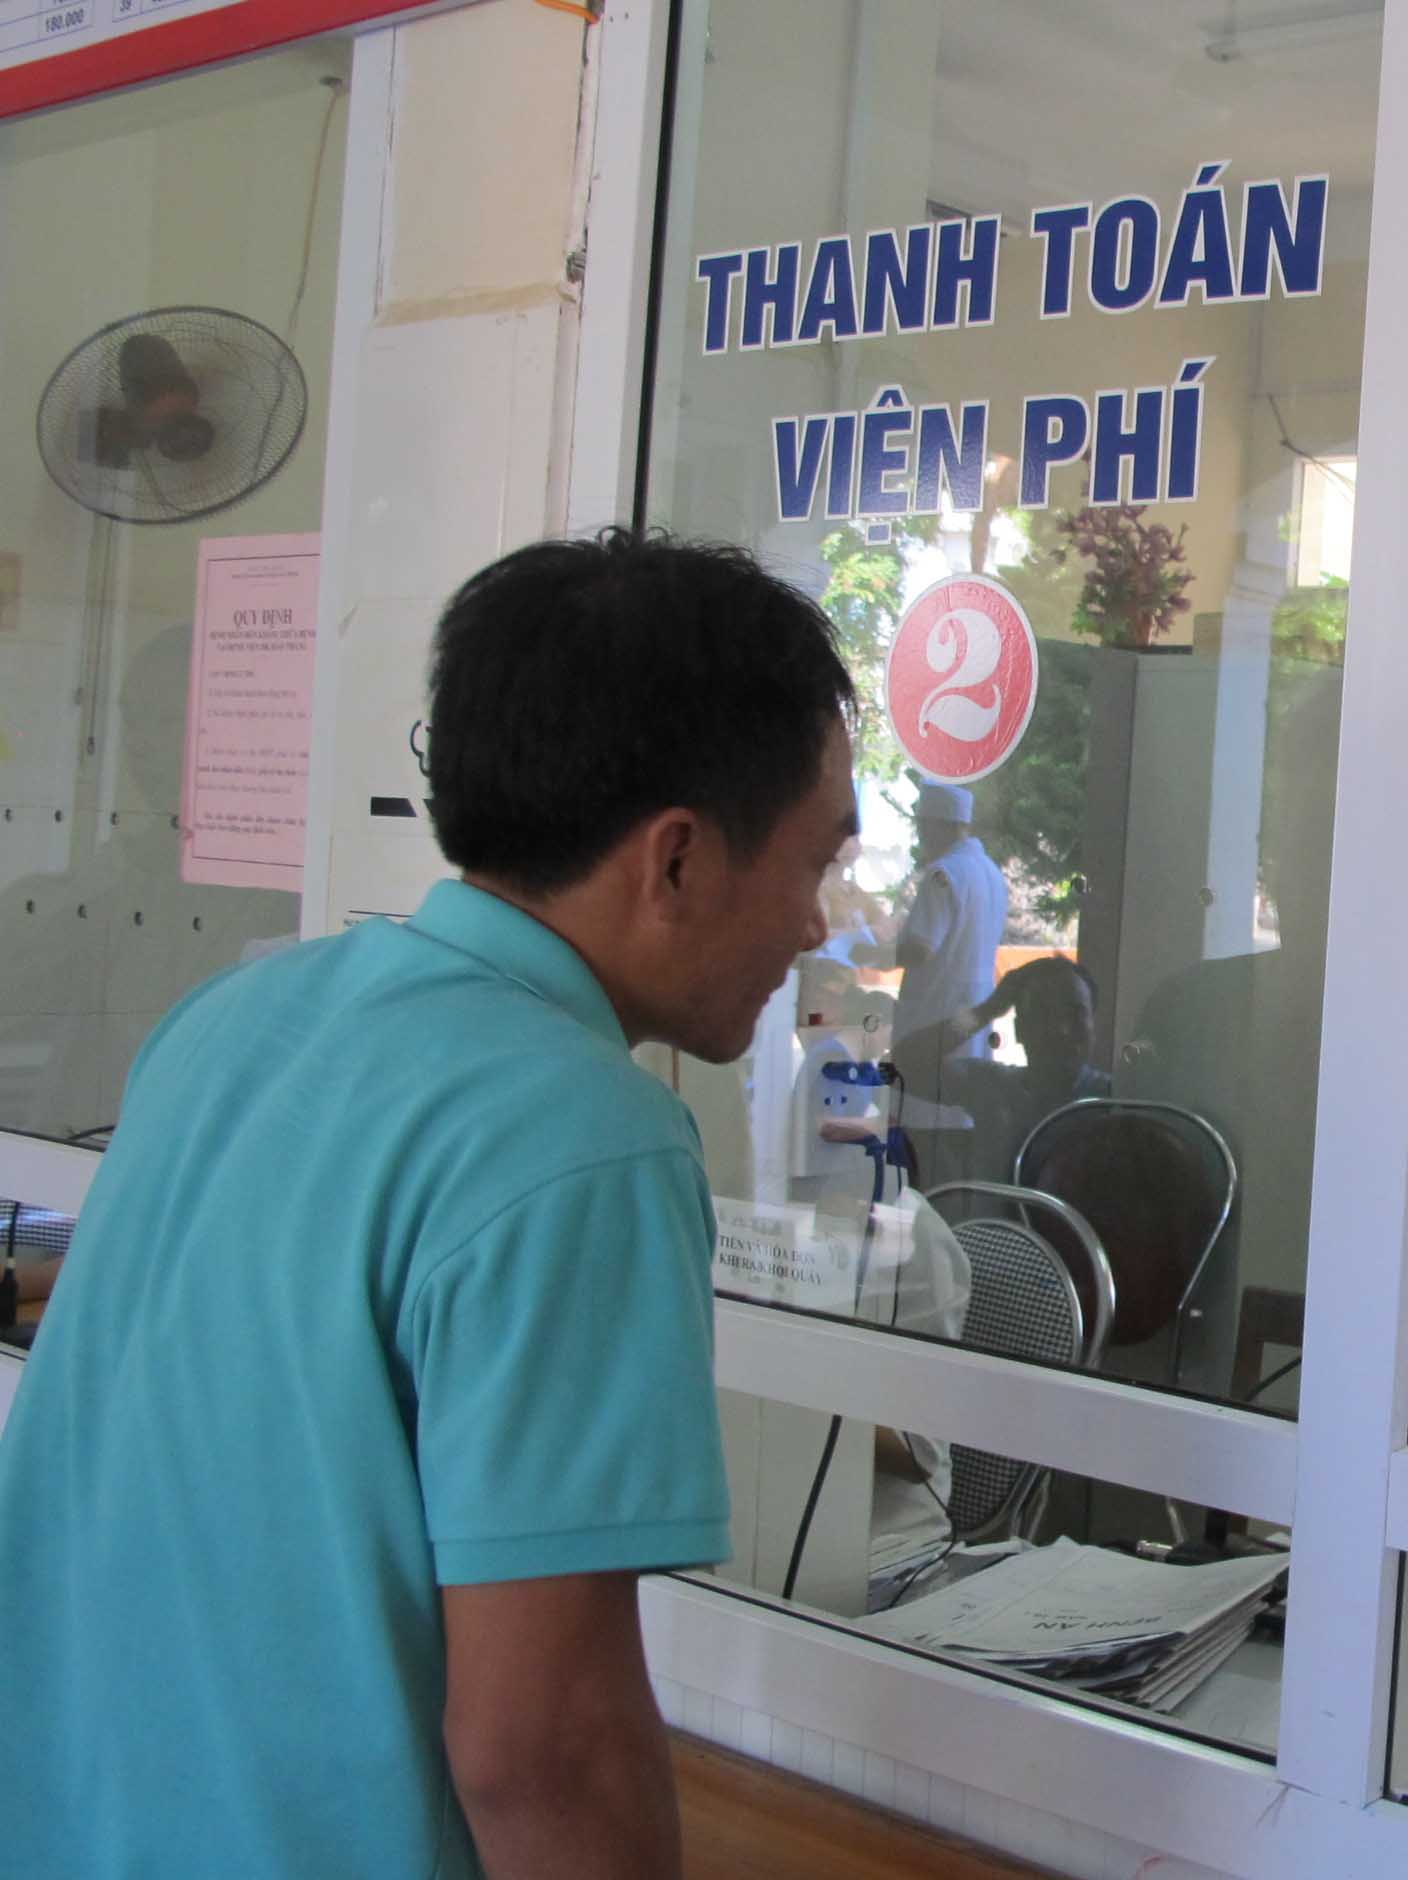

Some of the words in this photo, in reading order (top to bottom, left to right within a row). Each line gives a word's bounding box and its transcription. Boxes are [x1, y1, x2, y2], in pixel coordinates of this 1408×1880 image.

[697, 213, 1001, 355] THANH
[1031, 160, 1330, 320] TOÁN
[771, 384, 990, 546] VIỆN
[1018, 355, 1217, 510] PHÍ
[918, 608, 1002, 742] 2
